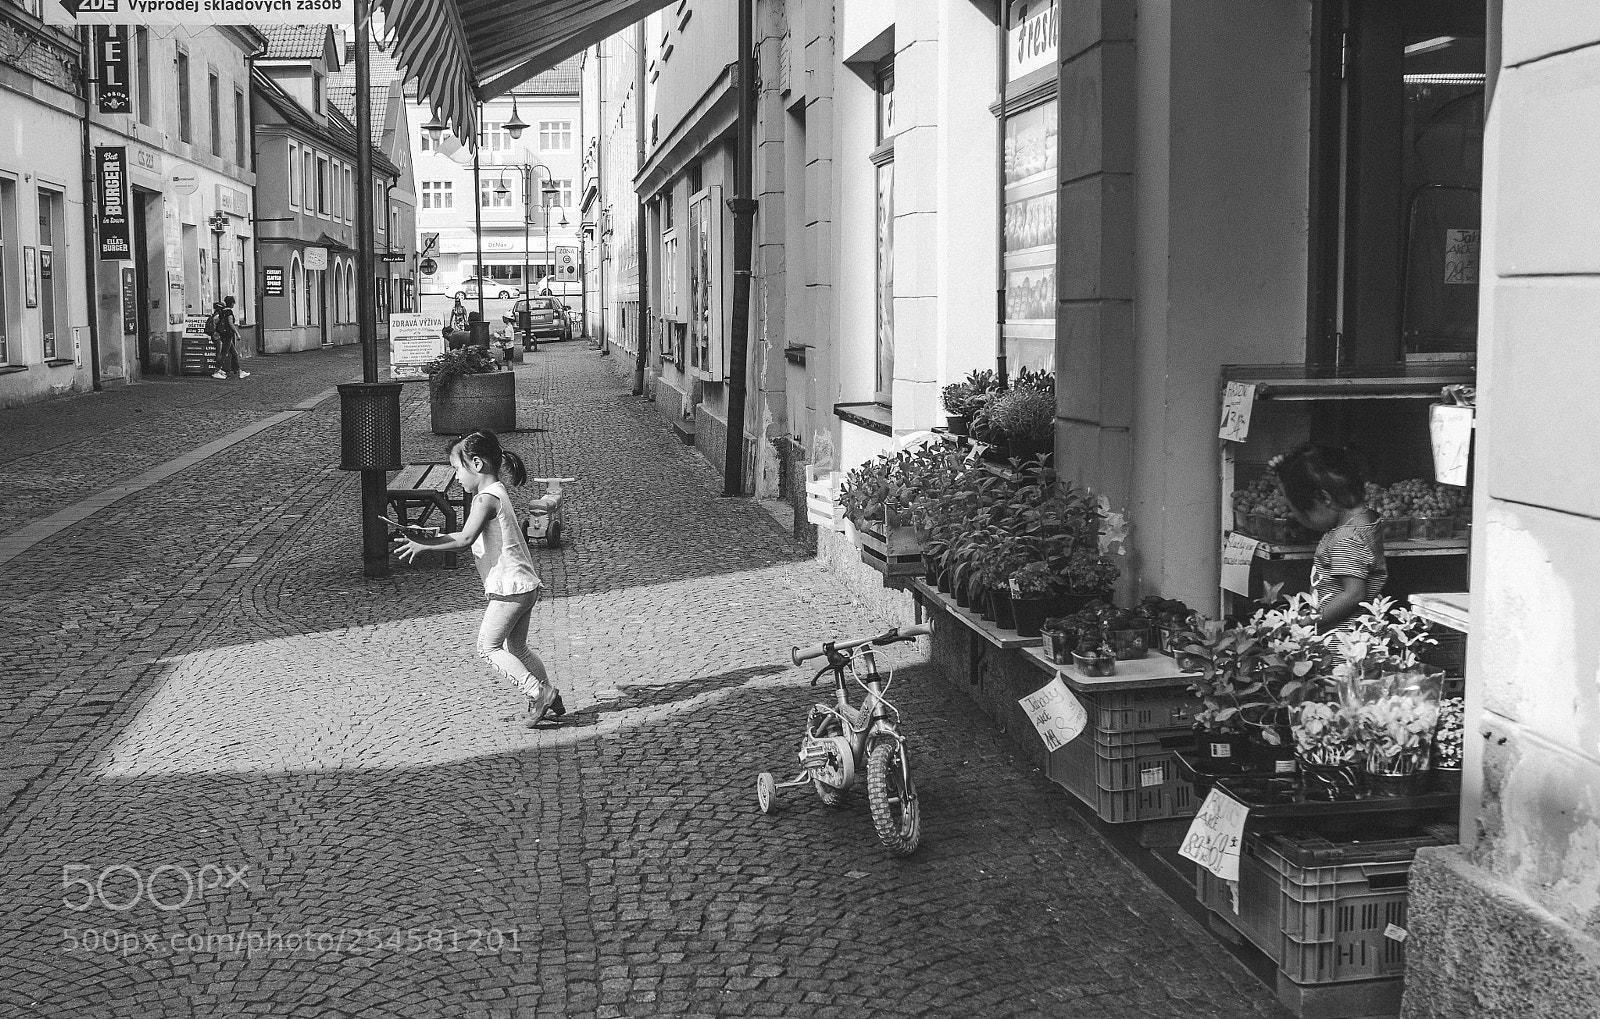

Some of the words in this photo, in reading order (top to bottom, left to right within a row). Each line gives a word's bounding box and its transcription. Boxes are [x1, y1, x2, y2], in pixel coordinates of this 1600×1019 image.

[79, 0, 115, 10] ZDE
[103, 161, 122, 216] BURGER
[103, 244, 128, 252] BURGER
[392, 318, 418, 327] ZDRAVÁ
[419, 317, 442, 326] VÝŽIVA
